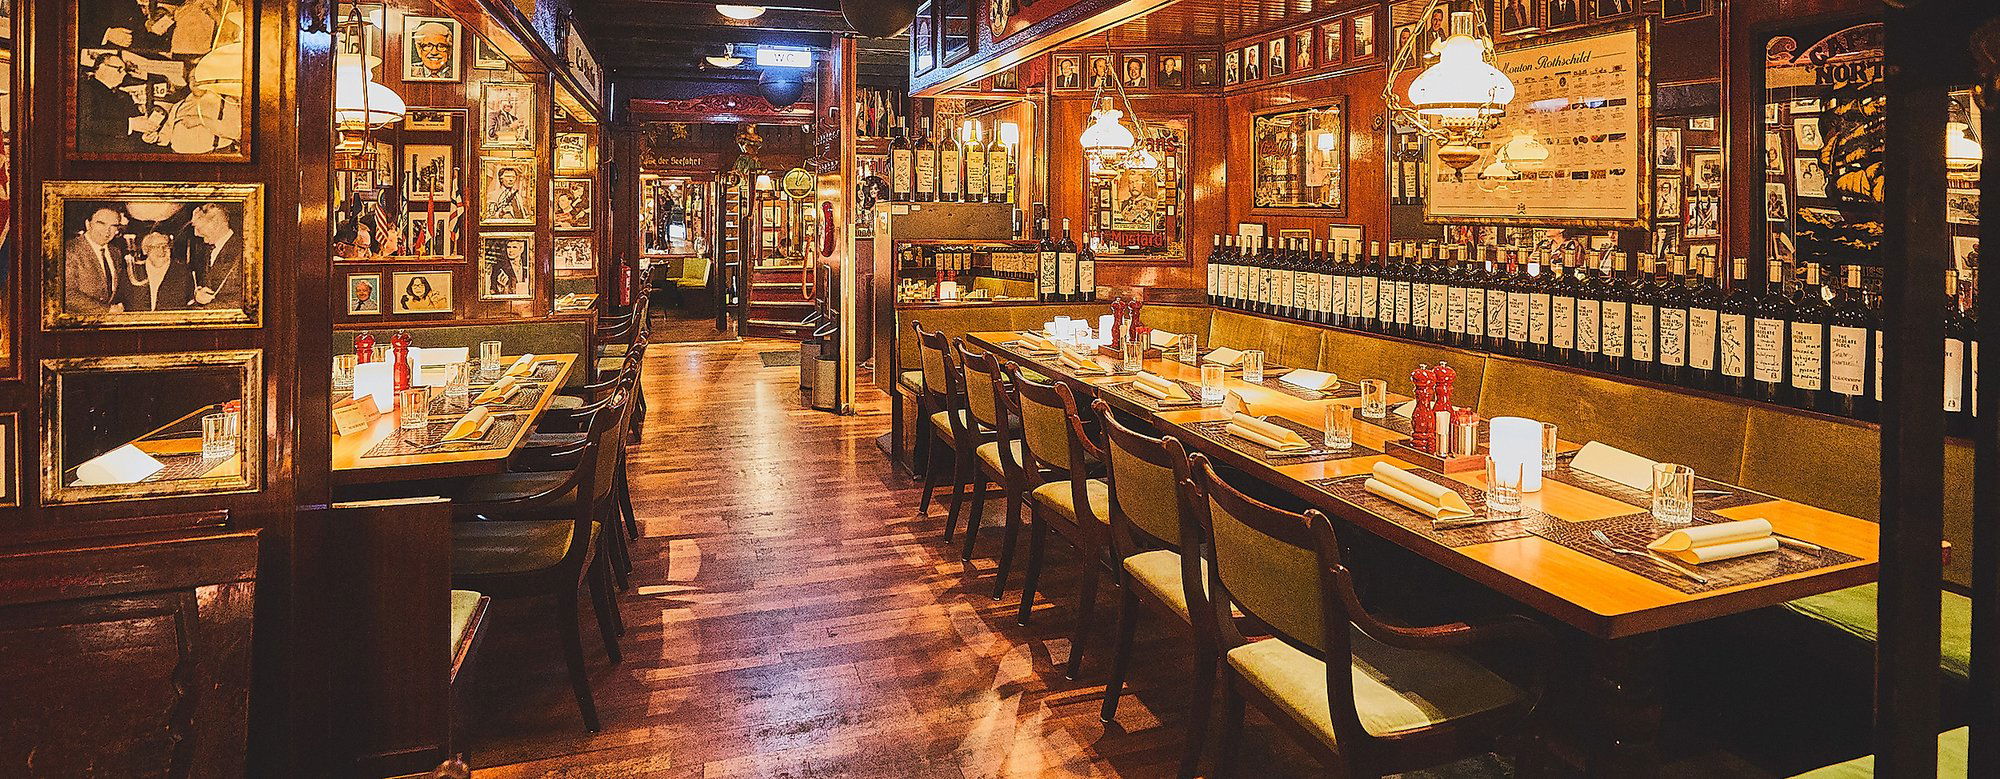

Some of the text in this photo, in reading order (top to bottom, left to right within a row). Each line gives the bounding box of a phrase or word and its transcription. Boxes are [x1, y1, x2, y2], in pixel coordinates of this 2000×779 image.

[774, 53, 794, 63] WC
[1535, 50, 1592, 70] Rothschild
[1111, 231, 1163, 248] Mustard
